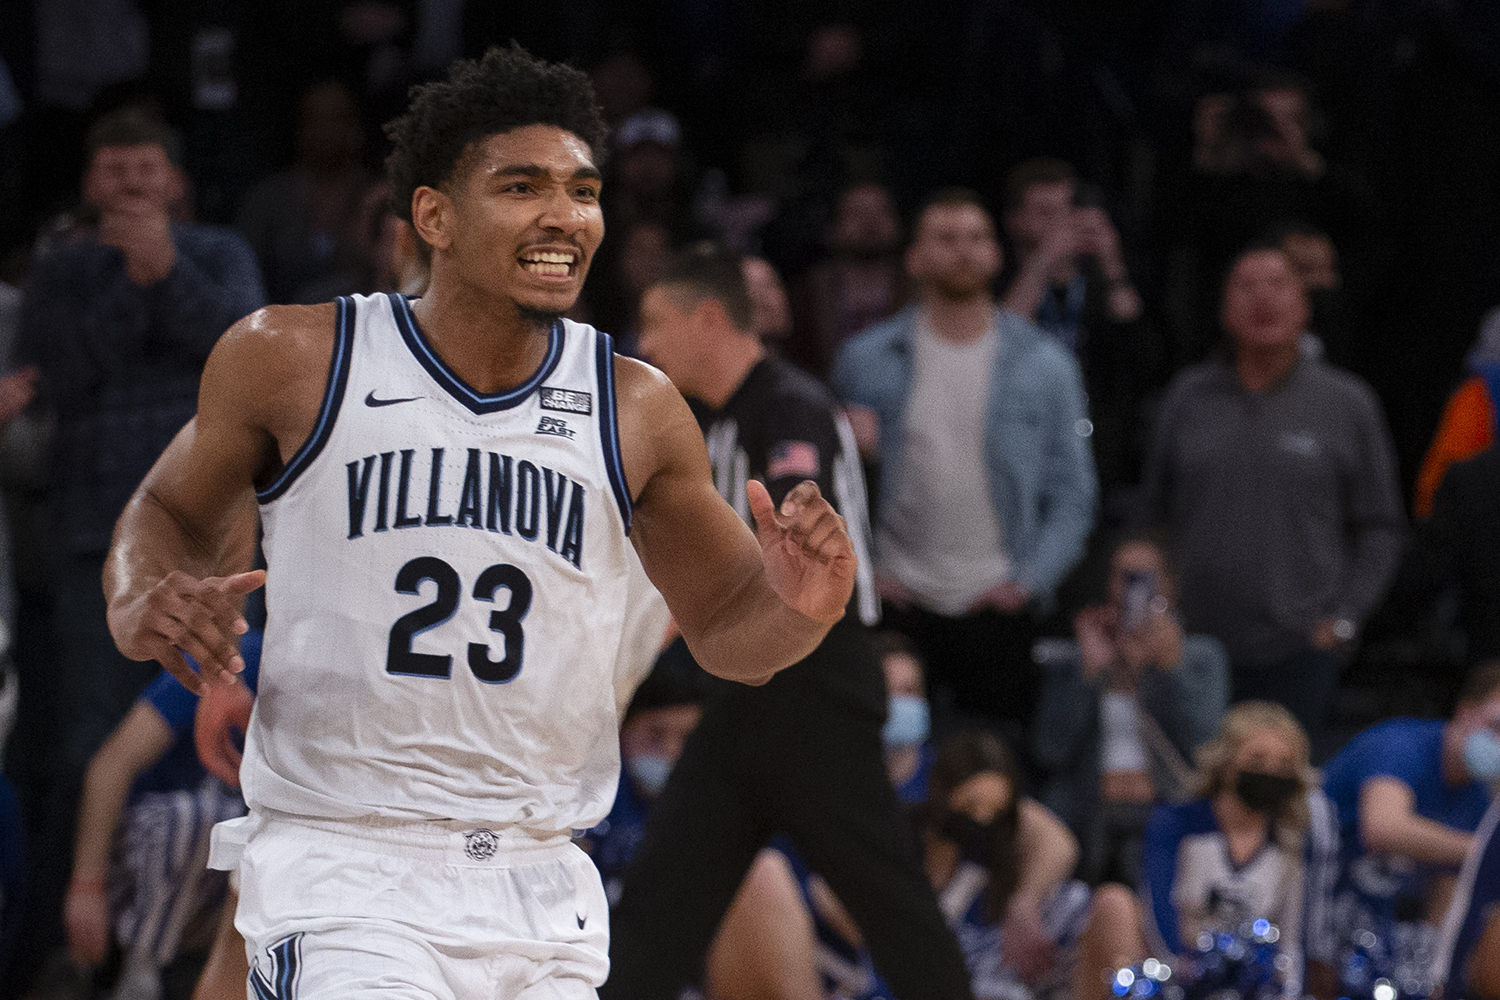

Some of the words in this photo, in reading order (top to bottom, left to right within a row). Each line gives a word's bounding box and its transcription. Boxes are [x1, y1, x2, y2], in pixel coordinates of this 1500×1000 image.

[537, 424, 576, 437] EAST
[540, 416, 567, 428] BIG
[345, 447, 586, 572] VILLANOVA
[386, 556, 533, 685] 23
